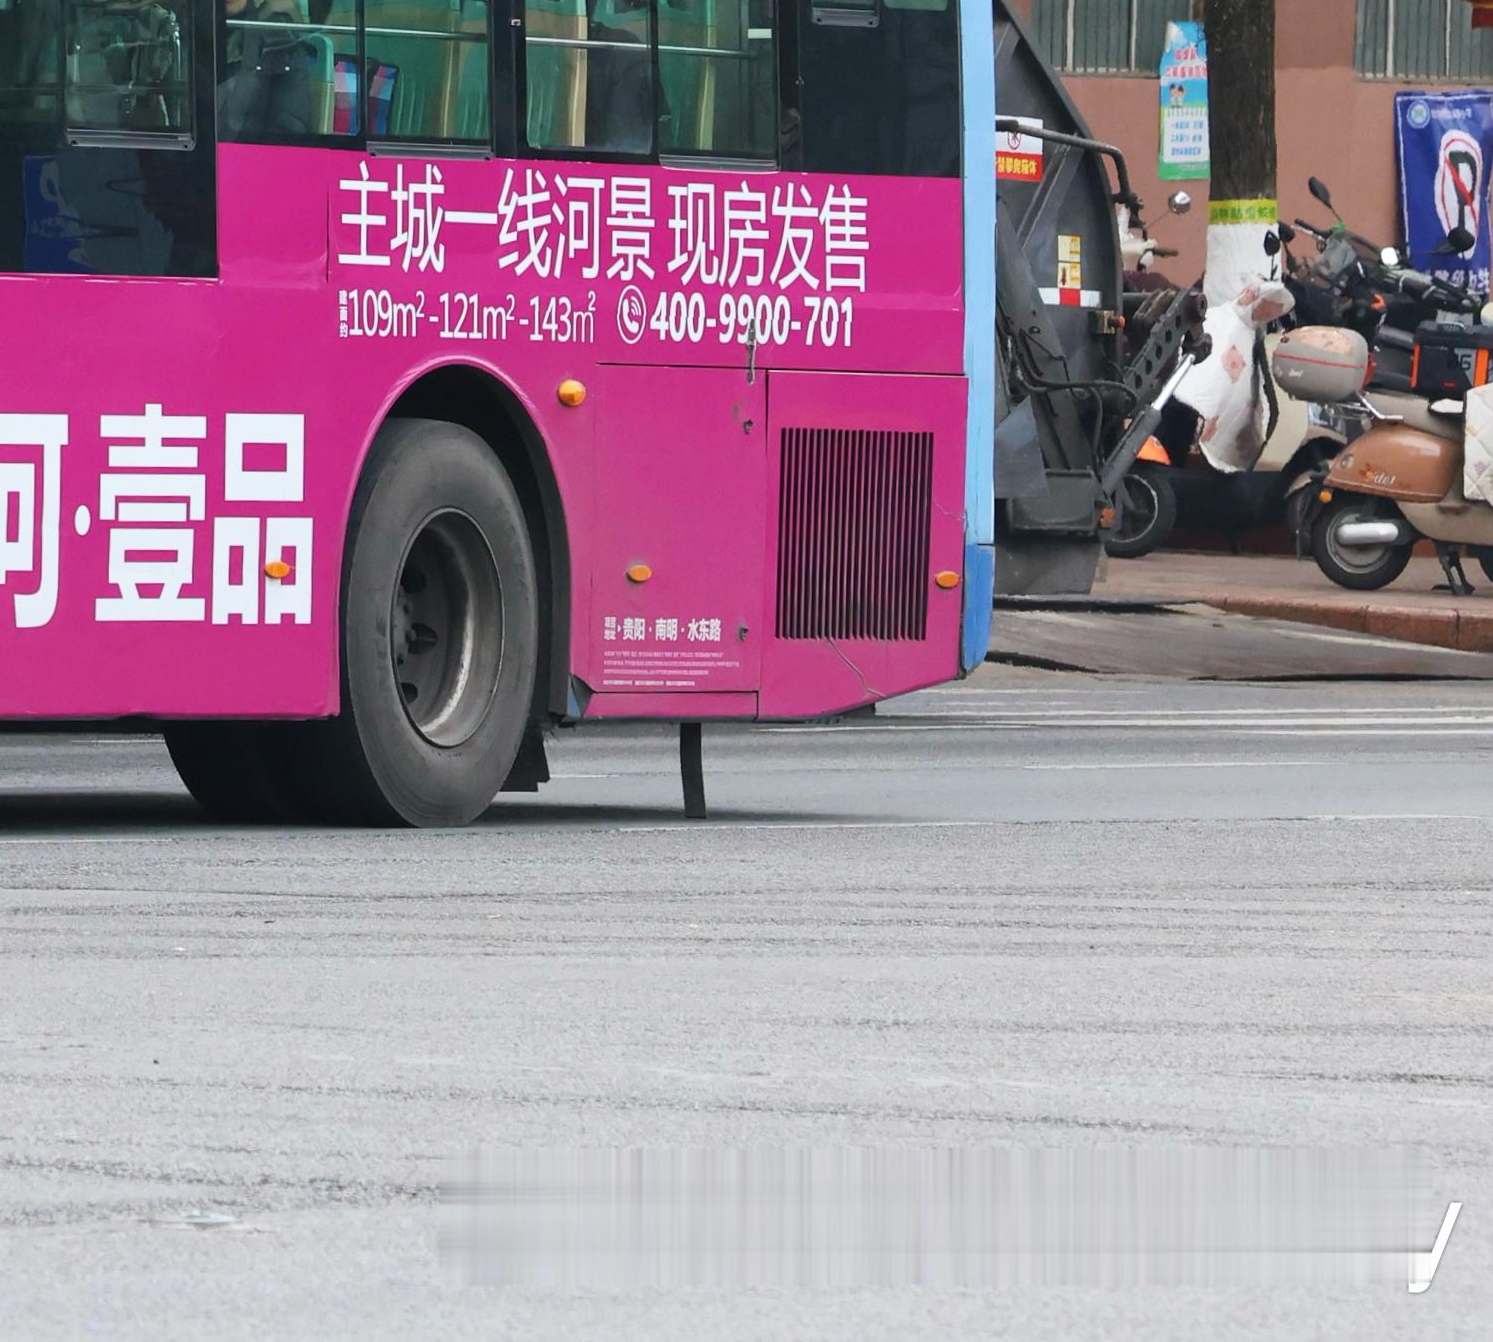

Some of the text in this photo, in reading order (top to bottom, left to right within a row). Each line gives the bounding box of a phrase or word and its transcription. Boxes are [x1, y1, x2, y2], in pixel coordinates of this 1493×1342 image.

[338, 160, 870, 292] 主城一线河景 现房发售
[650, 291, 853, 347] 400-9900-701
